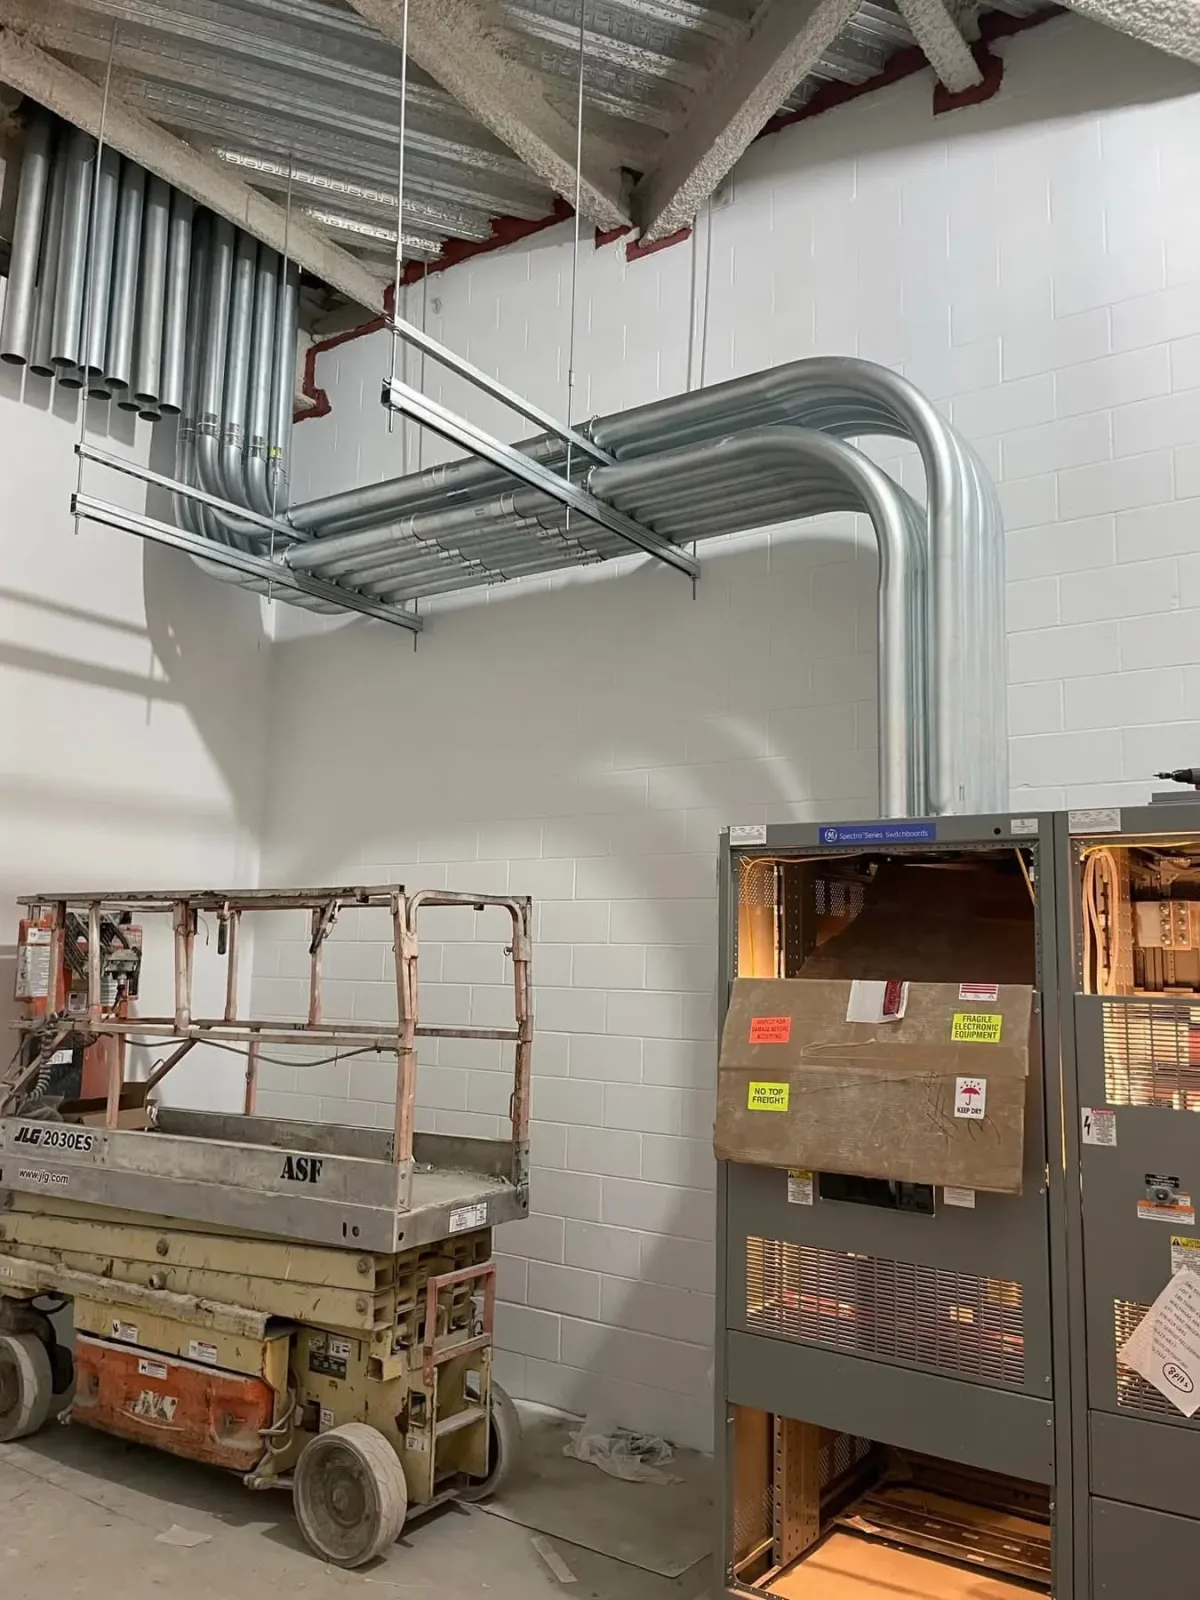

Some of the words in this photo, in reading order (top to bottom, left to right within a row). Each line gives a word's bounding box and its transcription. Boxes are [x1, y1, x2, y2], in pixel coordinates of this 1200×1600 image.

[885, 830, 929, 838] Switchboards
[962, 1015, 992, 1023] FRAGILE
[954, 1022, 999, 1031] ELECTRONIC
[954, 1030, 997, 1039] EQUIPMENT
[754, 1087, 766, 1095] NO
[769, 1088, 784, 1096] TOP
[752, 1095, 785, 1104] FREIGHT
[957, 1106, 970, 1114] KEEP
[14, 1127, 42, 1145] JLG
[43, 1130, 92, 1151] 2030ES
[280, 1156, 323, 1183] ASF
[20, 1168, 69, 1184] www.jlg.com
